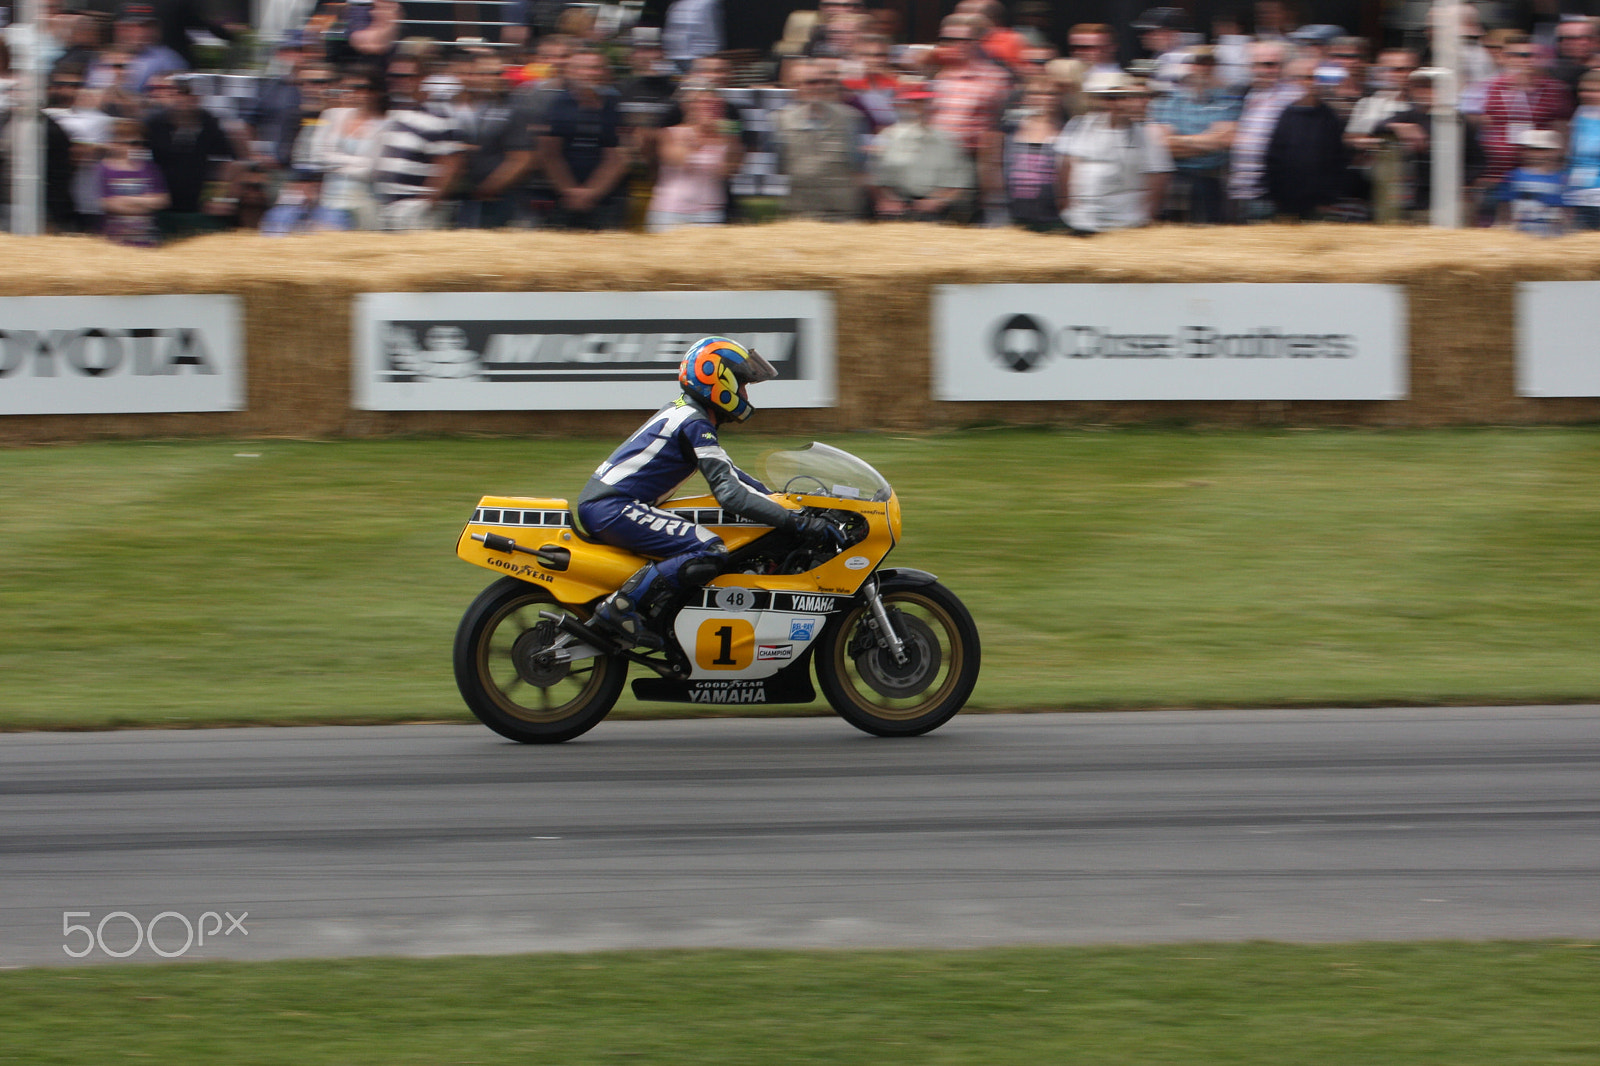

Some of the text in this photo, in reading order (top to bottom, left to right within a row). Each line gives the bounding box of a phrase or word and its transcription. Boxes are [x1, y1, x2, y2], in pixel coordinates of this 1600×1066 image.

[484, 332, 797, 363] MICHEN
[487, 557, 555, 584] GOODYEAR
[726, 592, 744, 606] 48
[791, 595, 836, 612] YAMAHA
[712, 626, 737, 665] 1
[759, 649, 792, 657] CHAMPION
[695, 680, 764, 690] GOODYEAR
[688, 688, 767, 704] YAMAHA
